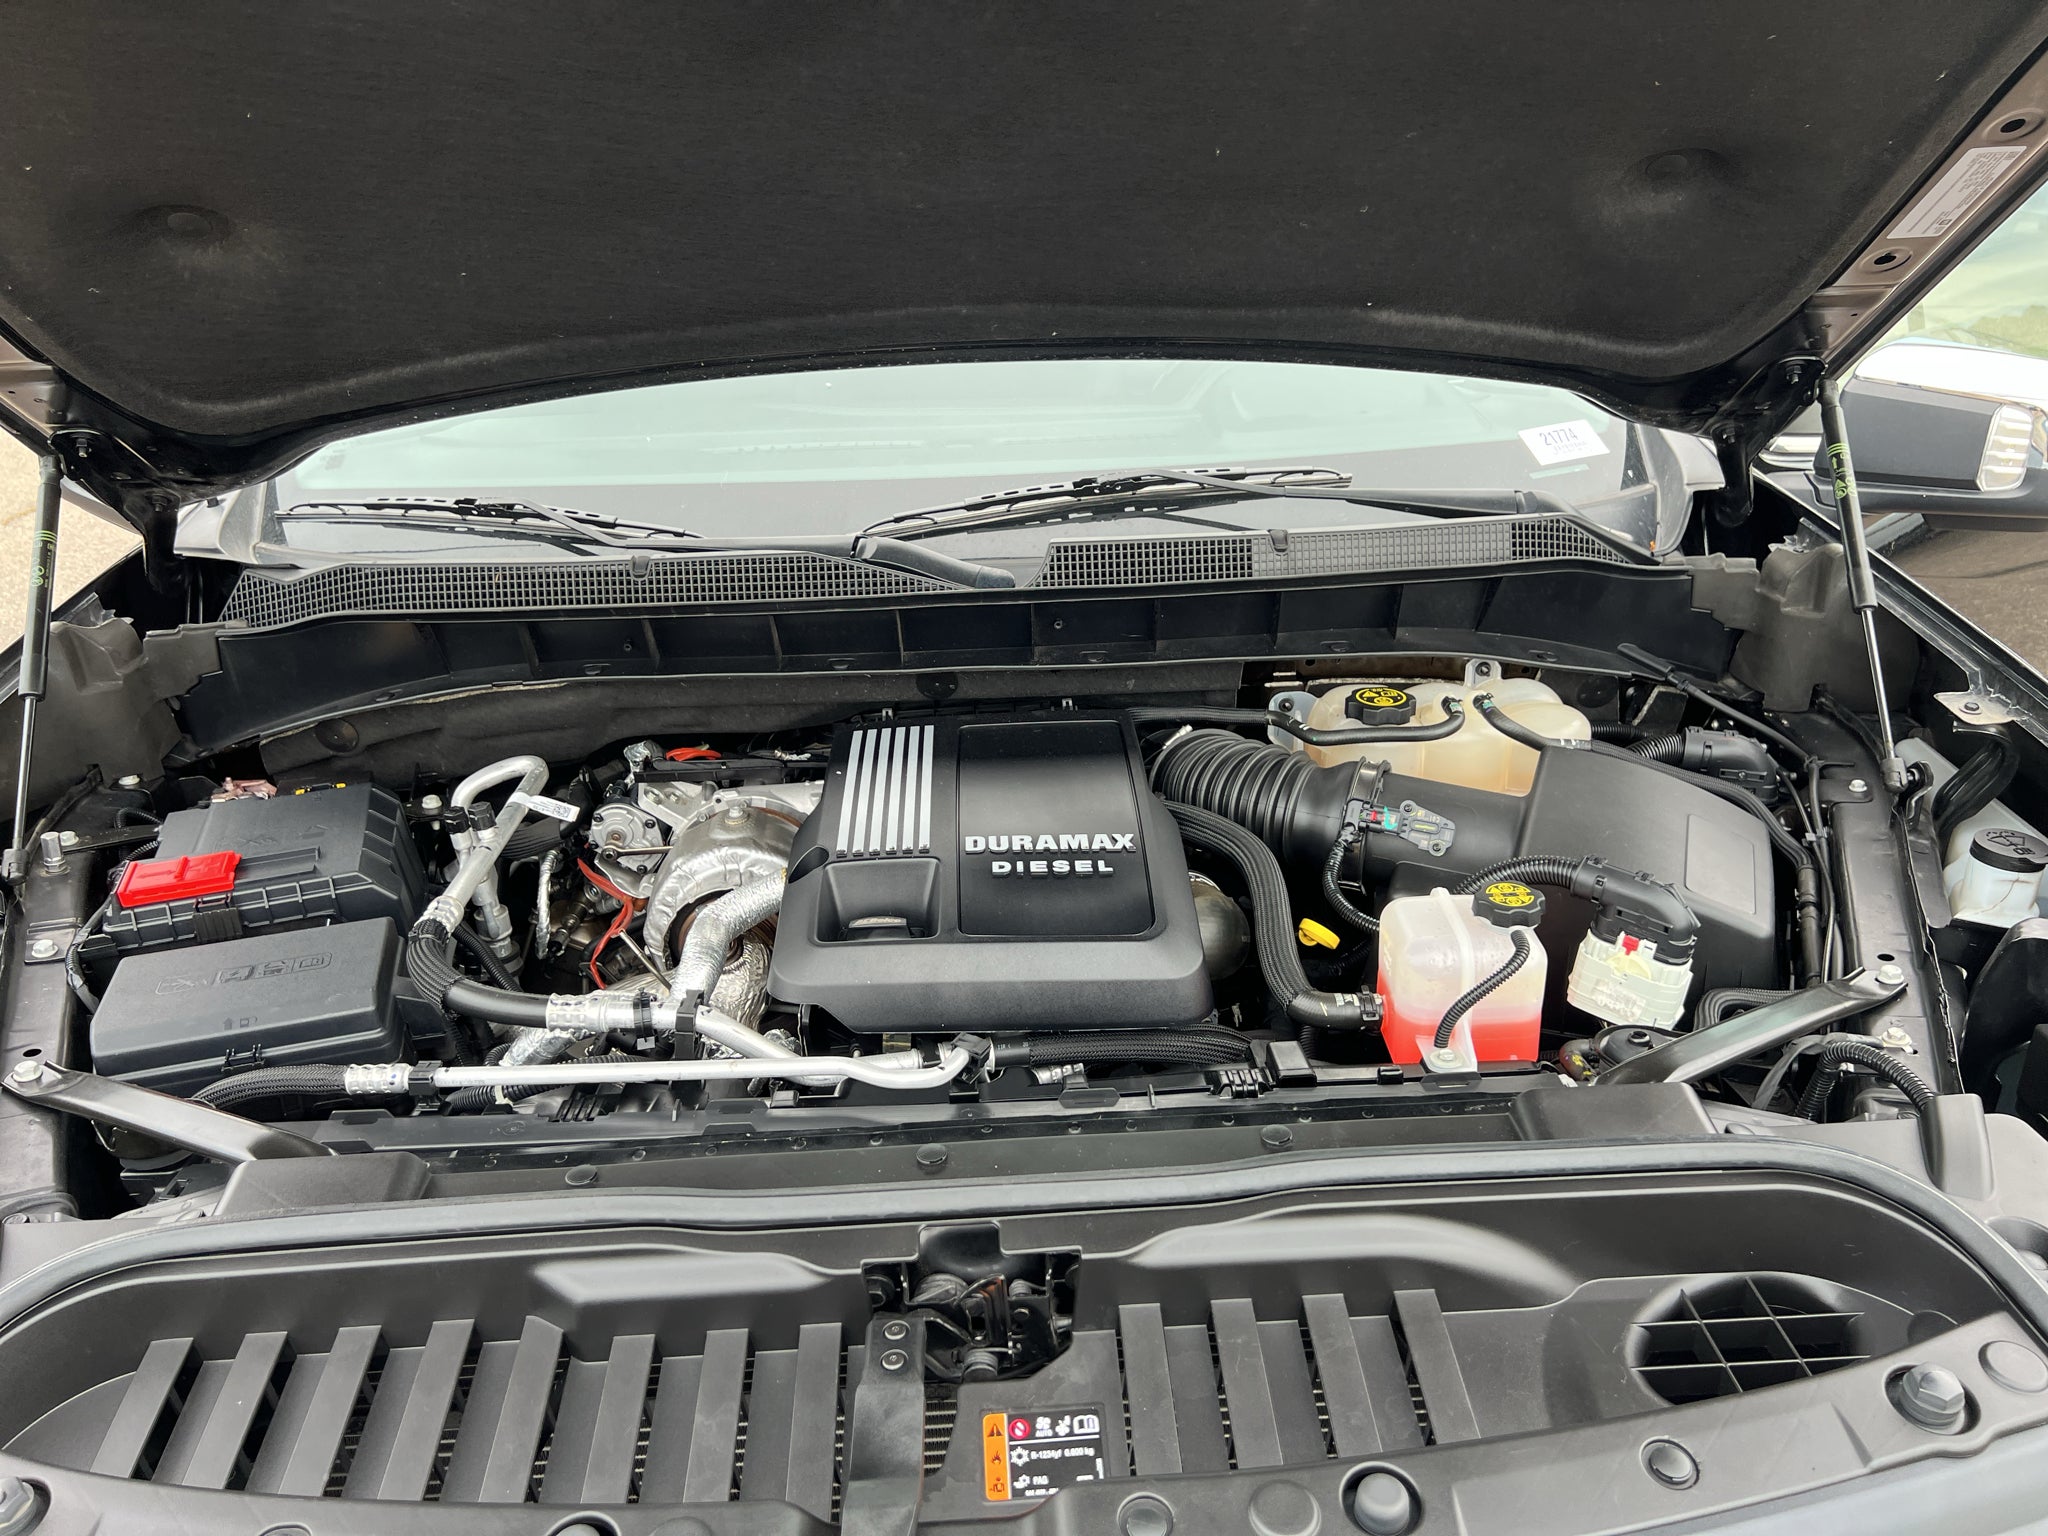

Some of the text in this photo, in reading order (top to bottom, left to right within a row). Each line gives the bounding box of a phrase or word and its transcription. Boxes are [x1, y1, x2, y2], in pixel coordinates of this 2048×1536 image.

[1539, 427, 1578, 446] 21774
[965, 833, 1137, 854] DURAMAX
[991, 859, 1115, 876] DIESEL
[1035, 1428, 1053, 1438] AUTO
